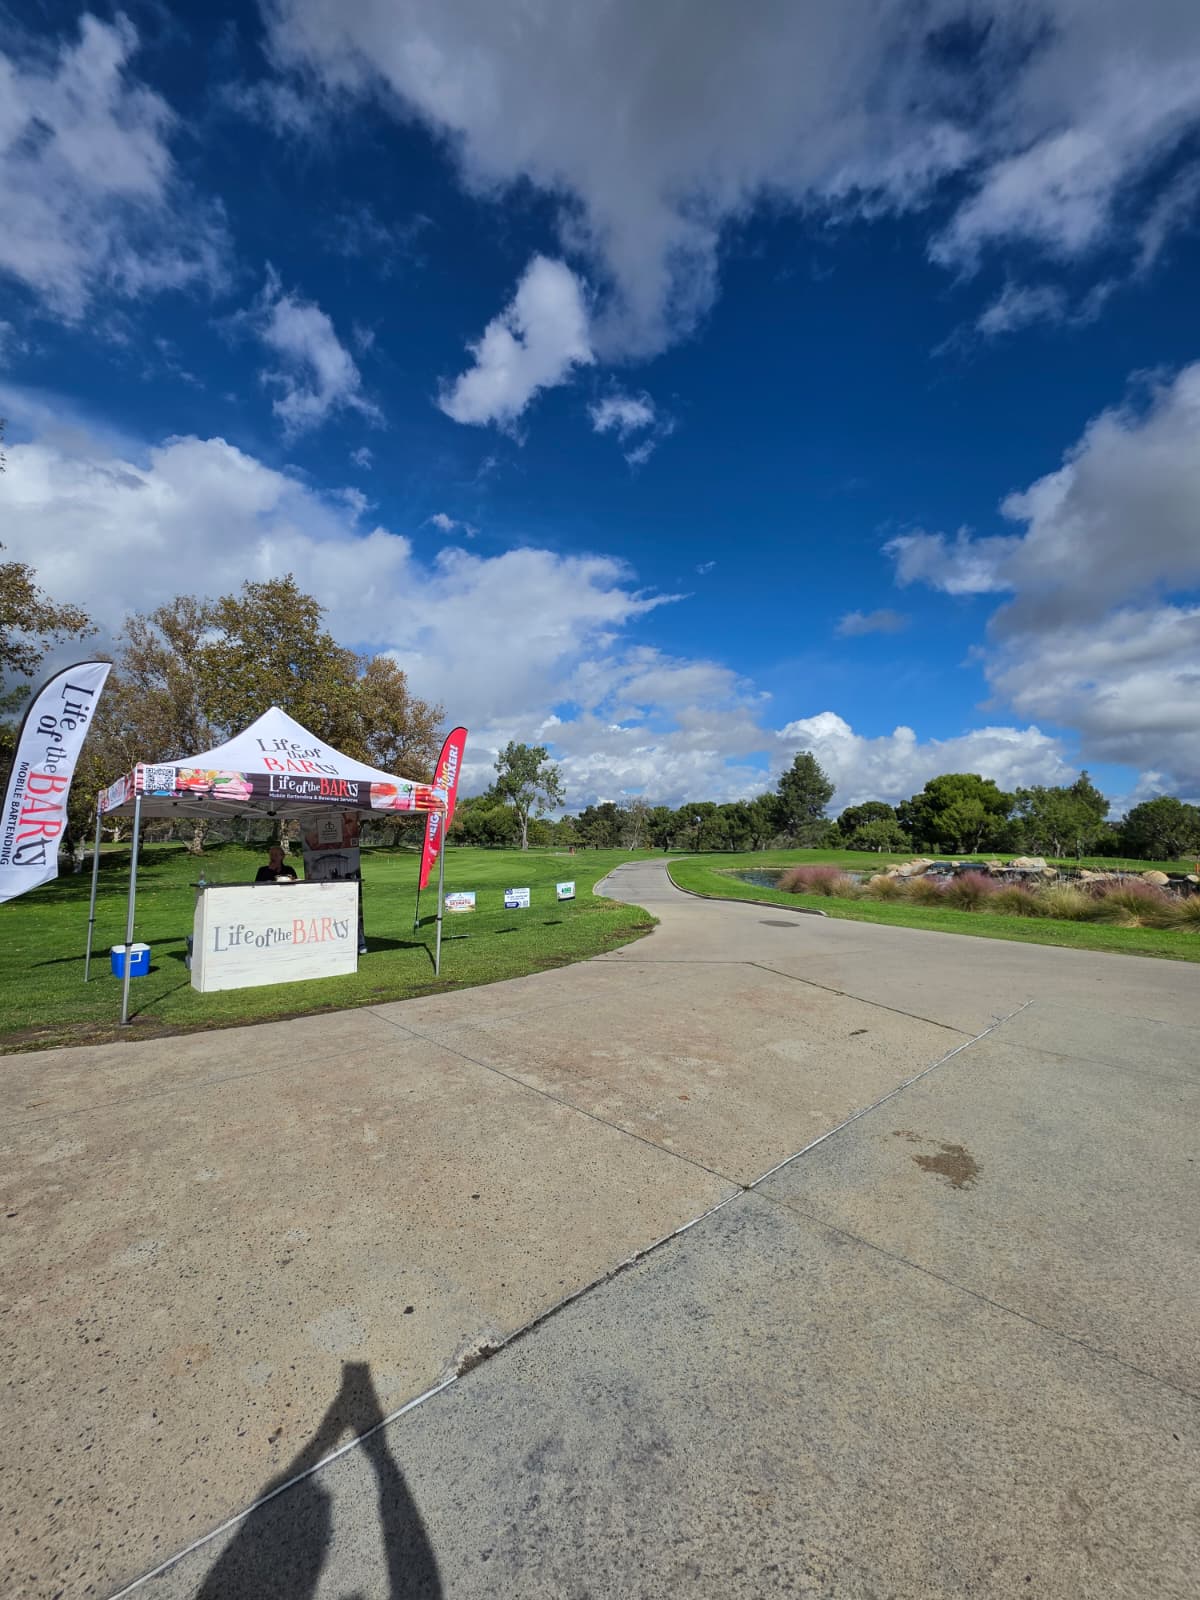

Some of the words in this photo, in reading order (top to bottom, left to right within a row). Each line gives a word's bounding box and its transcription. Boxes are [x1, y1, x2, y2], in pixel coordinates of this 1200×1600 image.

[60, 682, 95, 731] Life
[36, 715, 63, 742] of
[256, 738, 301, 752] Life
[43, 746, 67, 773] the
[263, 757, 340, 775] BARty
[447, 744, 459, 788] MIXER!
[13, 761, 30, 798] MOBILE
[269, 774, 296, 792] Life
[295, 780, 310, 794] of
[307, 781, 321, 792] the
[320, 777, 359, 797] BARty
[0, 800, 21, 865] BARTENDING
[12, 771, 68, 866] BARty
[213, 924, 255, 952] Life
[255, 927, 274, 948] of
[273, 927, 292, 944] the
[292, 917, 350, 945] BARty
